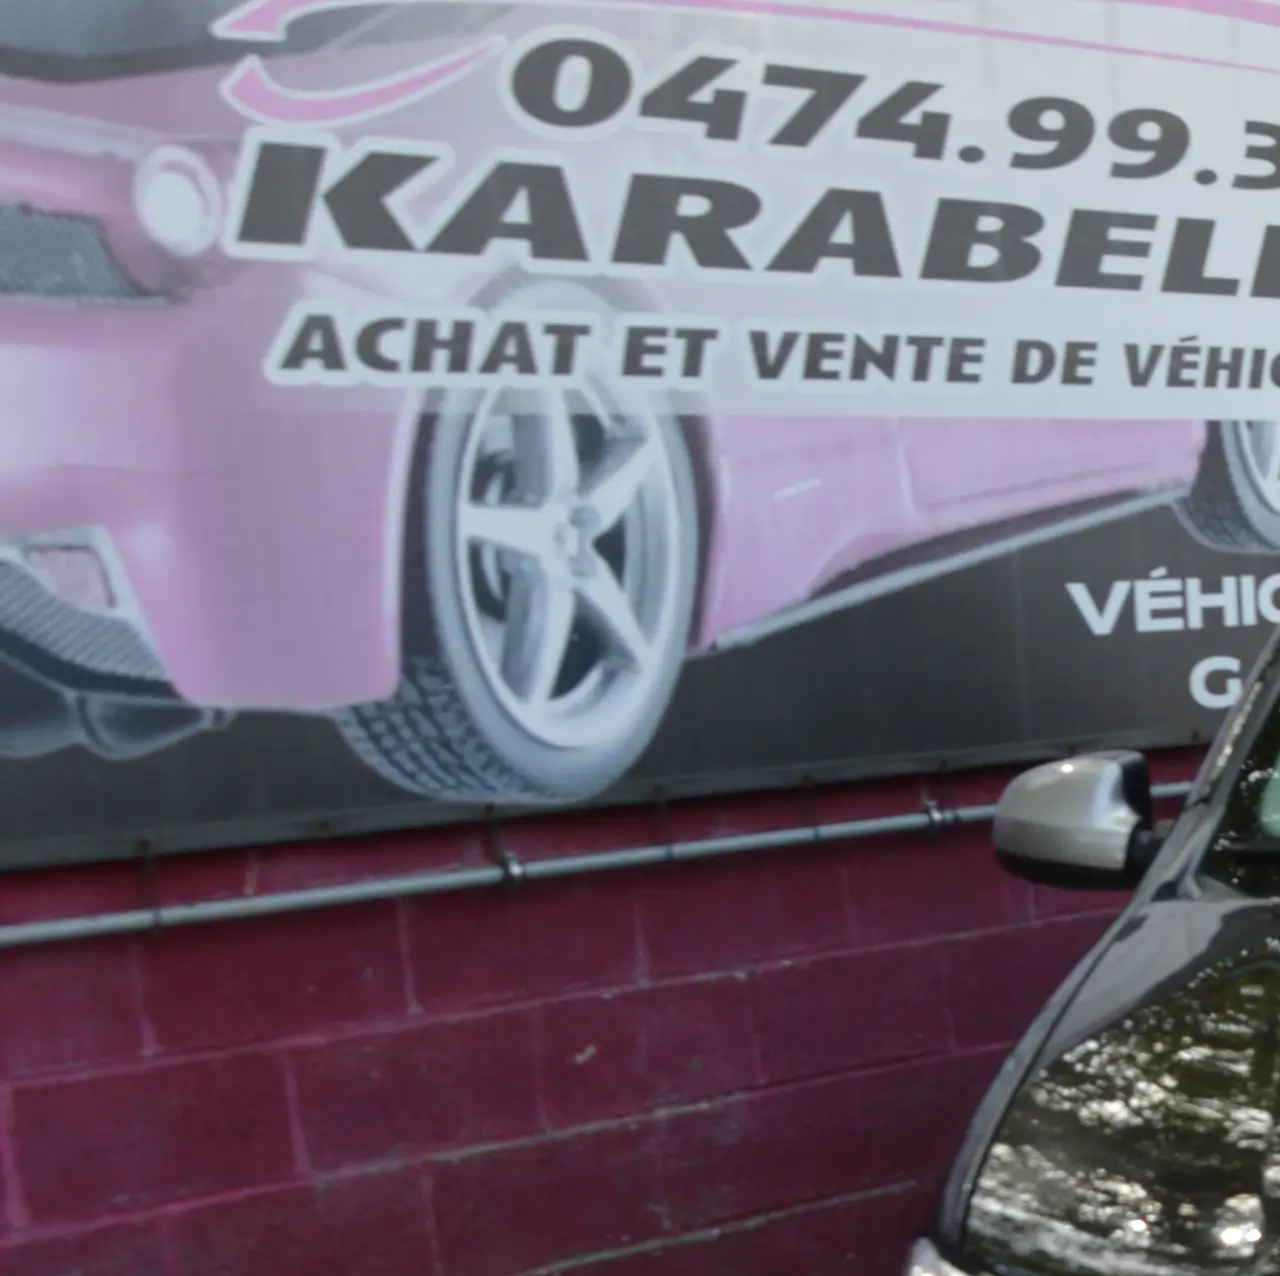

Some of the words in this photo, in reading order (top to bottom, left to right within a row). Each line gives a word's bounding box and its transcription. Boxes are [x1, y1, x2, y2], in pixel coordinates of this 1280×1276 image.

[280, 313, 591, 378] ACHAT
[620, 325, 719, 378] ET
[748, 330, 986, 383] VENTE
[1011, 338, 1098, 387] DE
